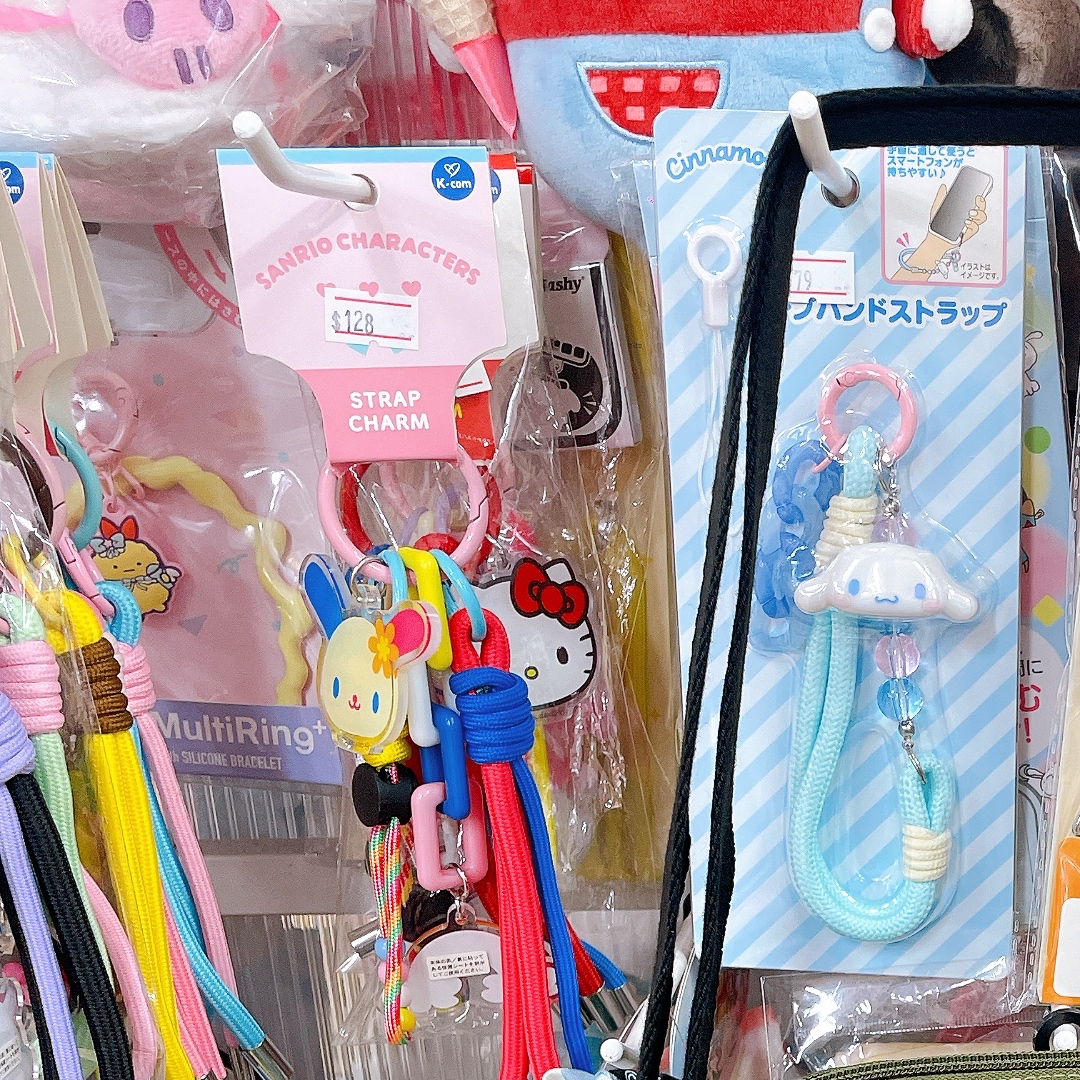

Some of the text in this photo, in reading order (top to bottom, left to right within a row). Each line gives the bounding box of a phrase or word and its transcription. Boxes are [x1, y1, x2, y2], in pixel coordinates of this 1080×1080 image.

[887, 156, 963, 168] スマートフォンが
[435, 178, 473, 191] K-com
[255, 232, 481, 290] SANRIO CHARACTERS
[960, 262, 992, 271] イラストは
[331, 310, 375, 335] $128
[349, 390, 422, 409] STRAP
[348, 412, 430, 431] CHARM
[181, 751, 228, 768] SILICONE
[230, 755, 283, 771] BRACELET
